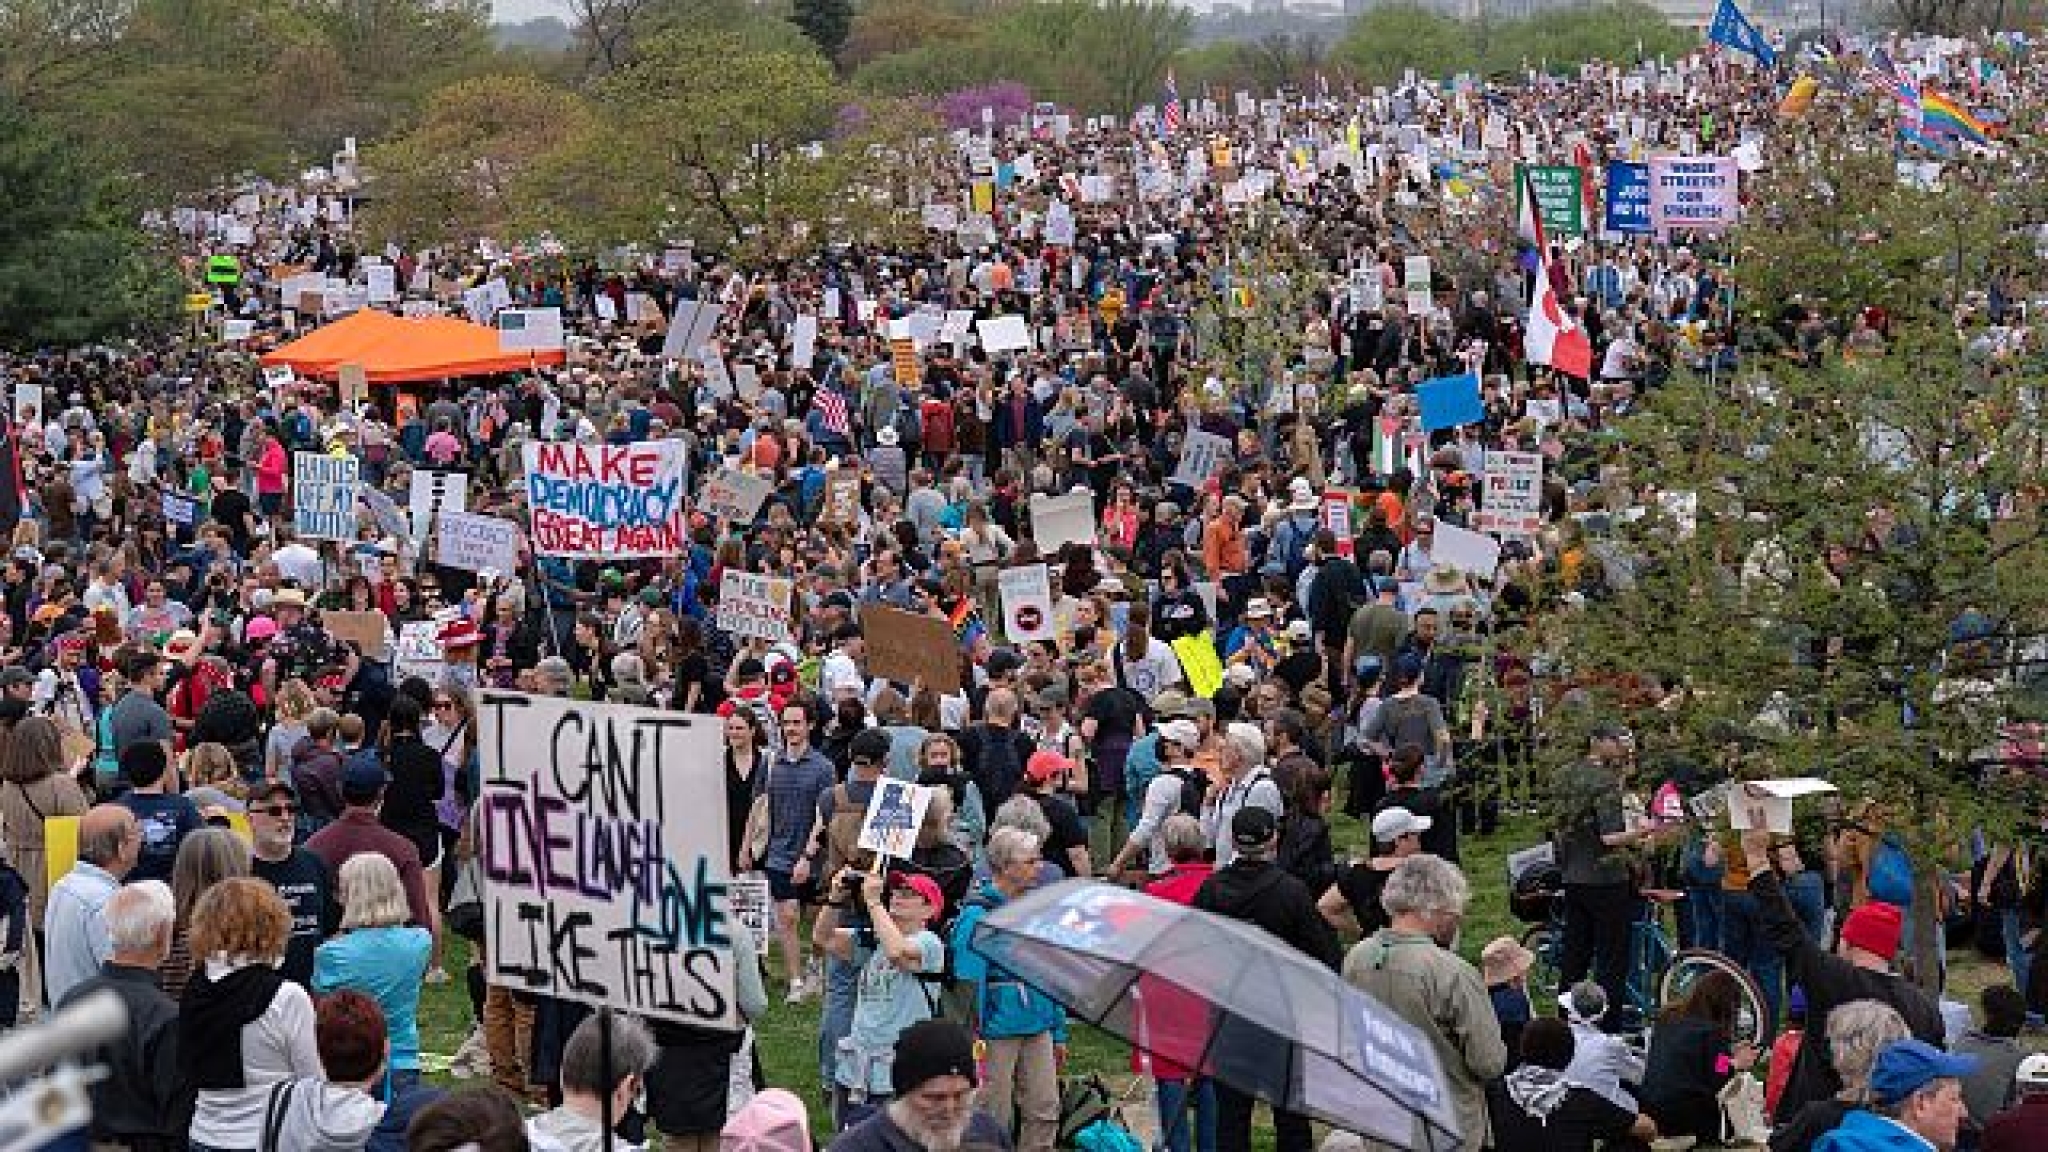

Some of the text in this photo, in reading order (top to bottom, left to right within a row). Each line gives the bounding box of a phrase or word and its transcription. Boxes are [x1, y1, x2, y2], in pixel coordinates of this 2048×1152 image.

[1660, 175, 1726, 187] STREETS?
[1670, 162, 1716, 173] WHOSE
[1663, 204, 1723, 218] STREETS!
[1676, 191, 1704, 202] OUR
[298, 454, 356, 484] HANDS
[539, 443, 659, 486] MAKE
[298, 482, 326, 510] OFF
[530, 473, 680, 527] DEMOCRACY
[533, 508, 681, 553] GREAT AGAIN
[482, 695, 531, 790] I
[482, 770, 578, 897] LIVE
[577, 811, 667, 907] LAUGH
[633, 853, 731, 950] LOVE
[495, 895, 728, 1020] LIKE THIS
